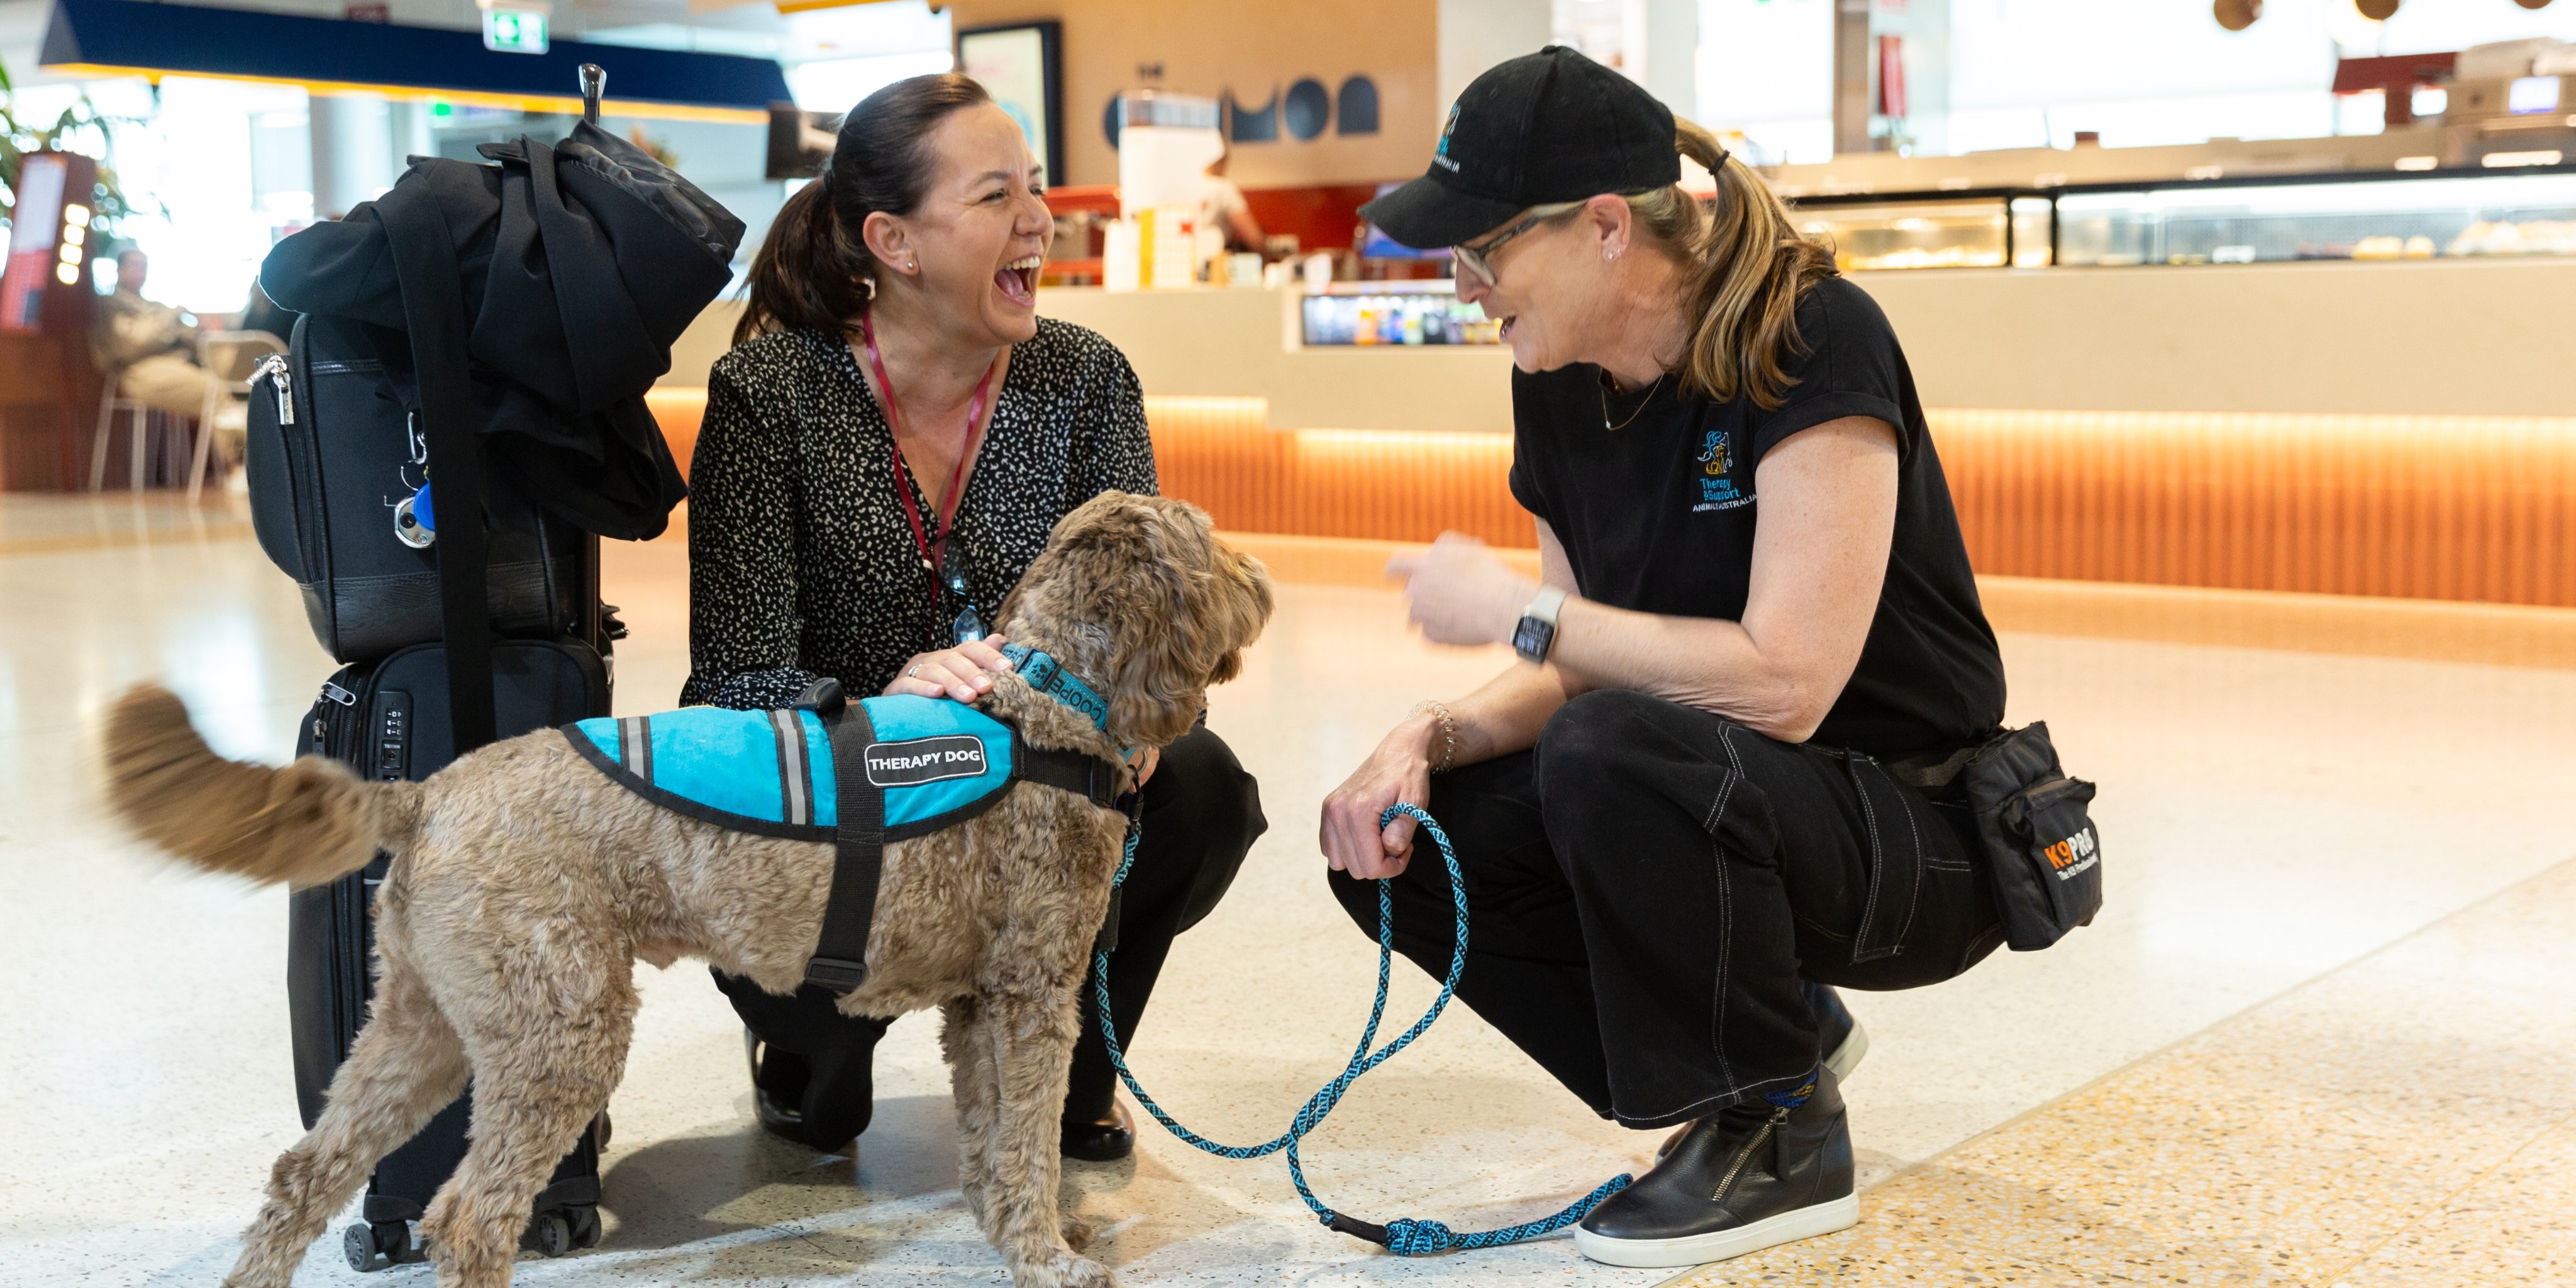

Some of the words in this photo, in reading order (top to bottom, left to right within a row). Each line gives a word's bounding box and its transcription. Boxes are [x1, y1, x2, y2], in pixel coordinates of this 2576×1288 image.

[1700, 478, 1731, 491] Therapy
[869, 752, 941, 770] THERAPY
[945, 750, 980, 762] DOG
[2044, 827, 2095, 870] K9PRO
